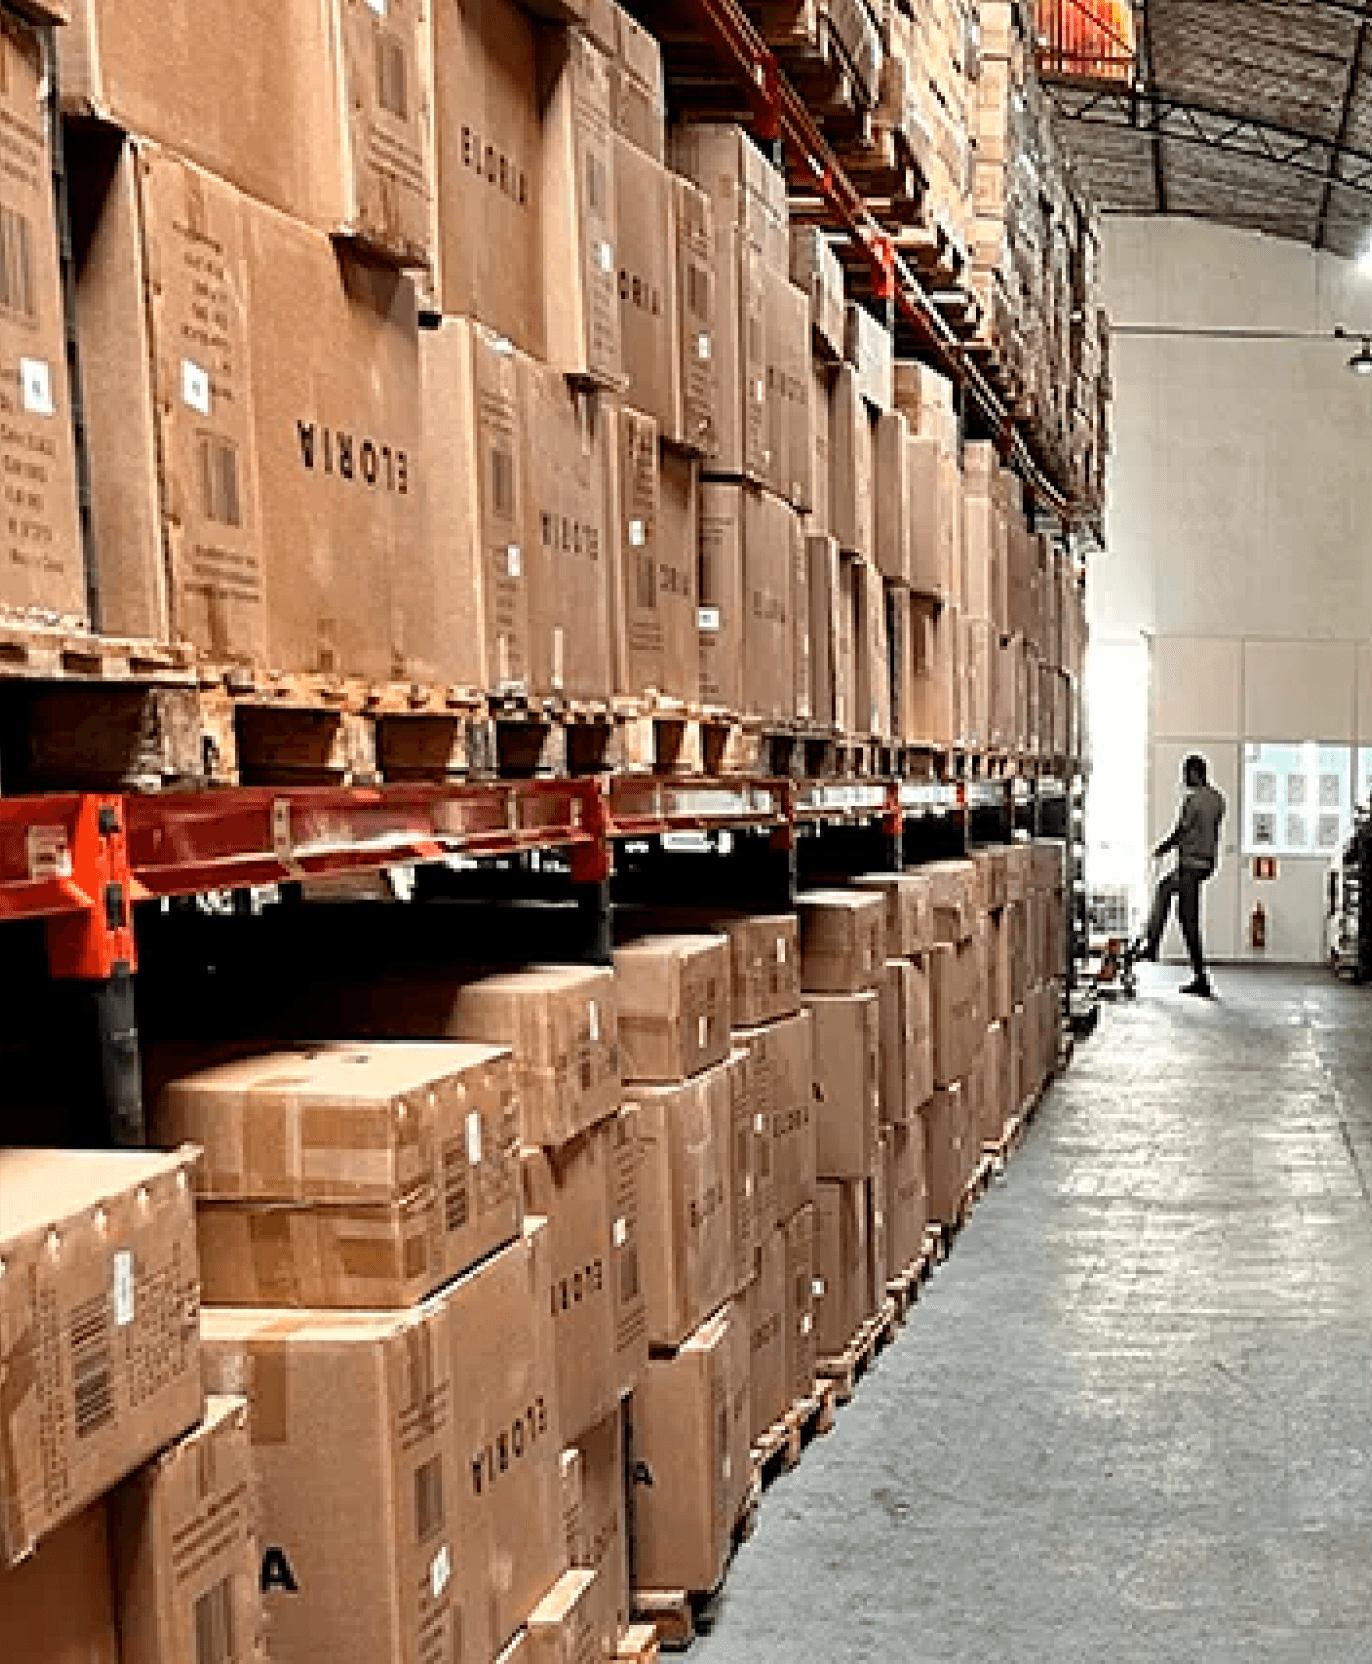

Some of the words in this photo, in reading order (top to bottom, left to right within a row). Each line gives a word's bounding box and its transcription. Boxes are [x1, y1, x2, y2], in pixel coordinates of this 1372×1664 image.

[461, 125, 528, 206] ELORIA
[617, 268, 660, 316] ORIA
[298, 420, 408, 494] ELORIA
[540, 509, 599, 561] ELORIA
[550, 1258, 603, 1318] ELORI
[470, 1396, 548, 1495] ELORIA
